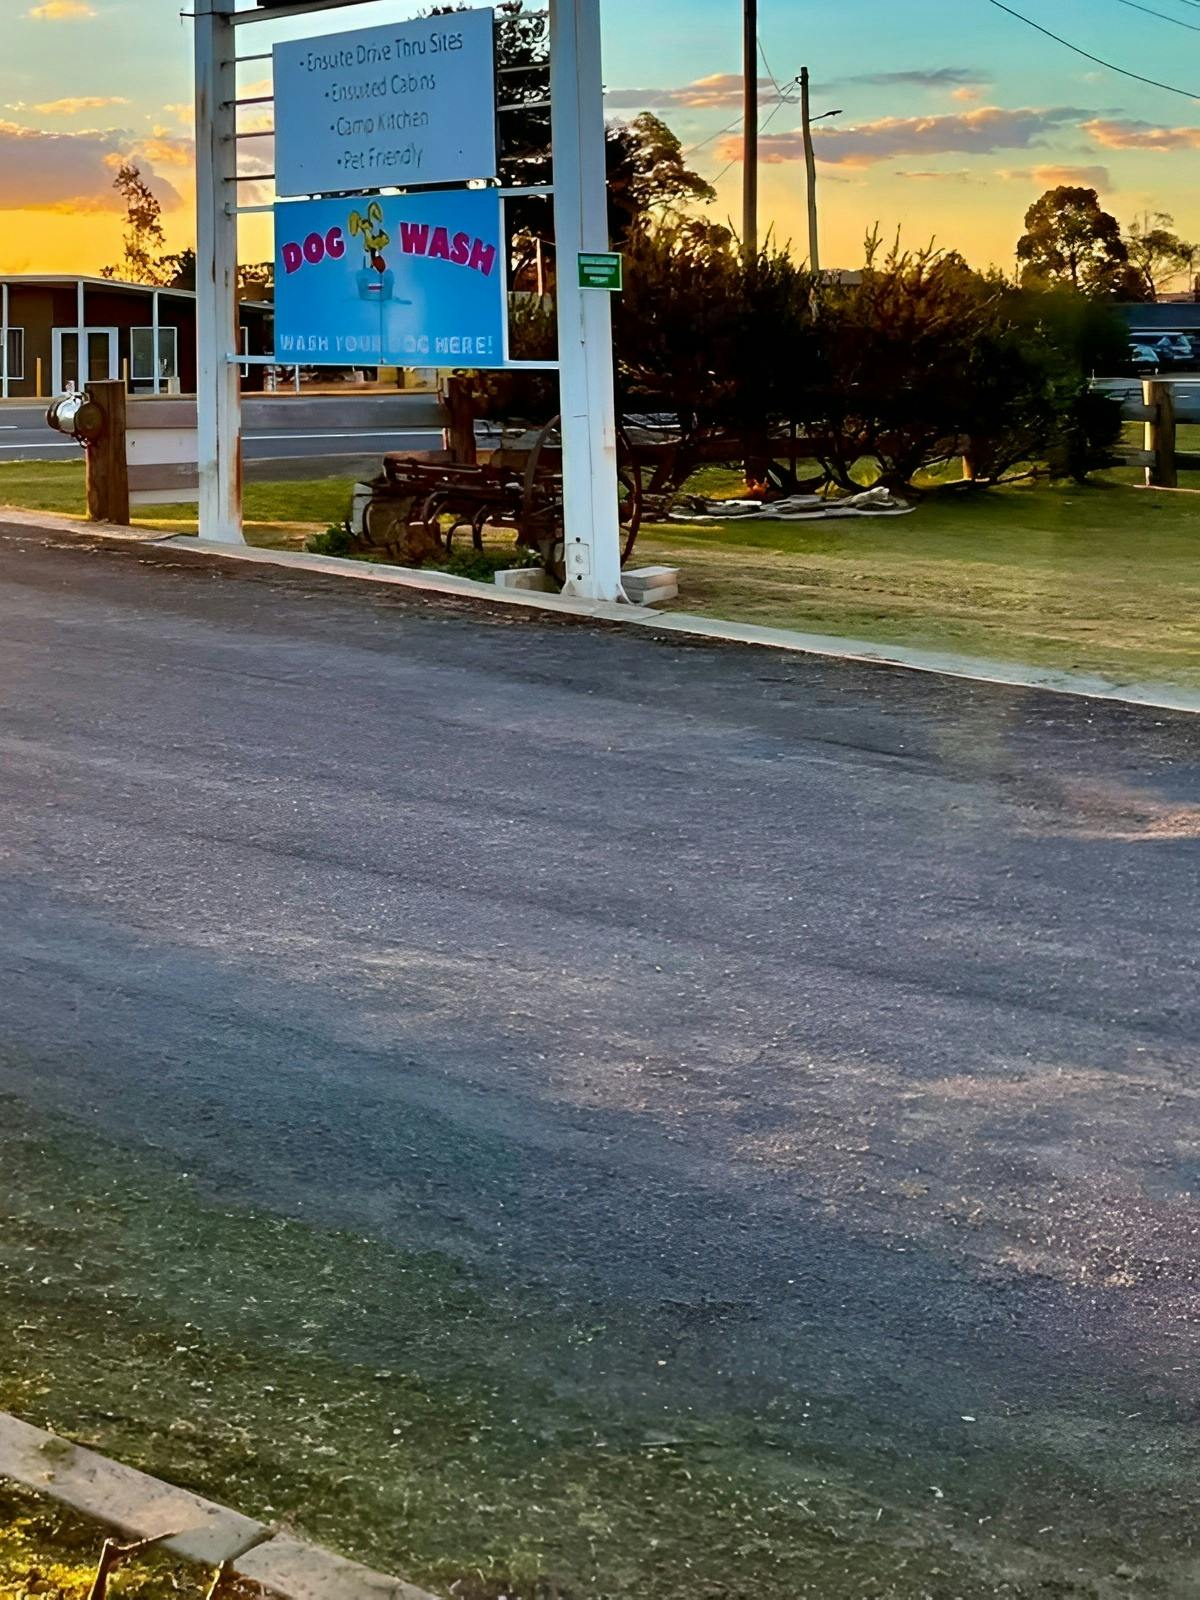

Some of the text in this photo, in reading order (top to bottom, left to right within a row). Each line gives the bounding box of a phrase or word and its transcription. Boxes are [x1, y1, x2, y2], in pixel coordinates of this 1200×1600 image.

[395, 36, 427, 59] Thru
[429, 31, 464, 54] Sites
[336, 109, 430, 137] Camp Kitchen
[344, 151, 366, 170] Pet
[282, 221, 498, 277] DOG WASH
